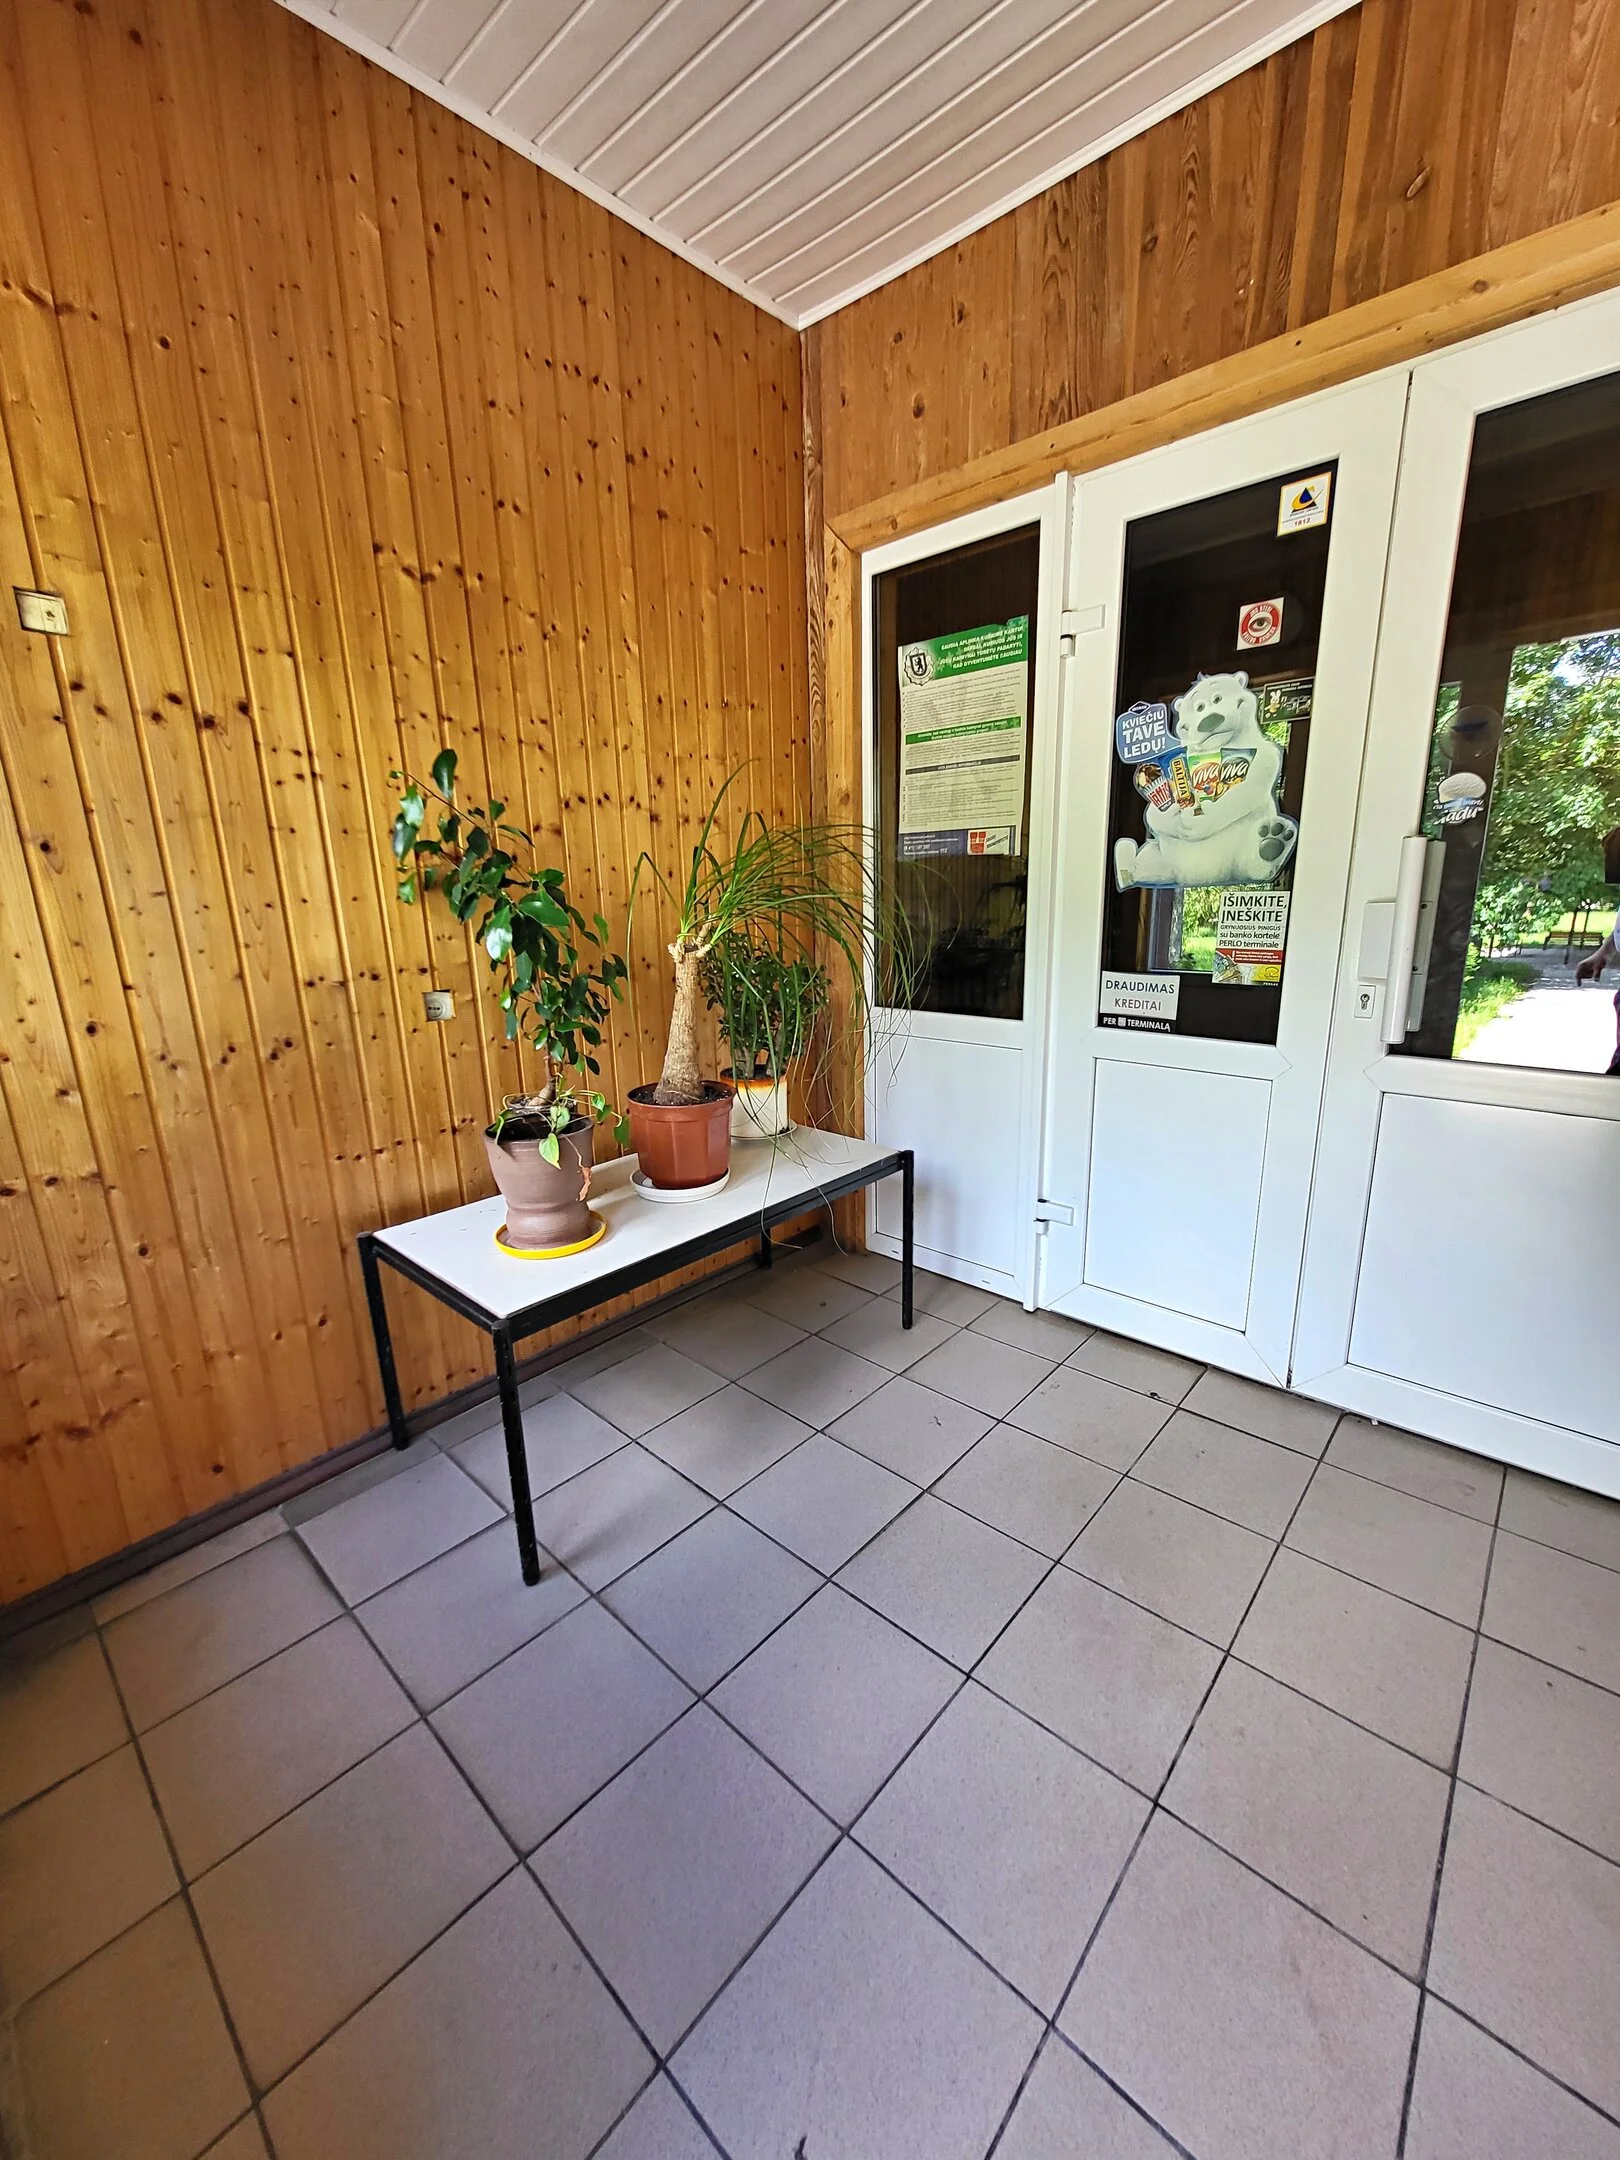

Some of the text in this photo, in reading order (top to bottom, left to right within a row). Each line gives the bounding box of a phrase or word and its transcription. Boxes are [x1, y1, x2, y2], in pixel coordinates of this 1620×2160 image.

[1122, 709, 1164, 730] KVIEČIU
[1123, 720, 1165, 744] TAVE
[1123, 737, 1166, 759] LEDŲ!
[1173, 760, 1188, 796] BALTIJA
[1223, 892, 1287, 909] IŠIMKITE,
[1222, 908, 1283, 924] ĮNEŠKITE
[1229, 931, 1252, 939] banko
[1253, 932, 1280, 940] kortele
[1219, 939, 1279, 949] PERLO terminale
[1105, 980, 1175, 994] DRAUDIMAS
[1114, 998, 1162, 1011] KREDITAI
[1103, 1017, 1117, 1025] PER
[1127, 1019, 1171, 1032] TERMINALĄ
